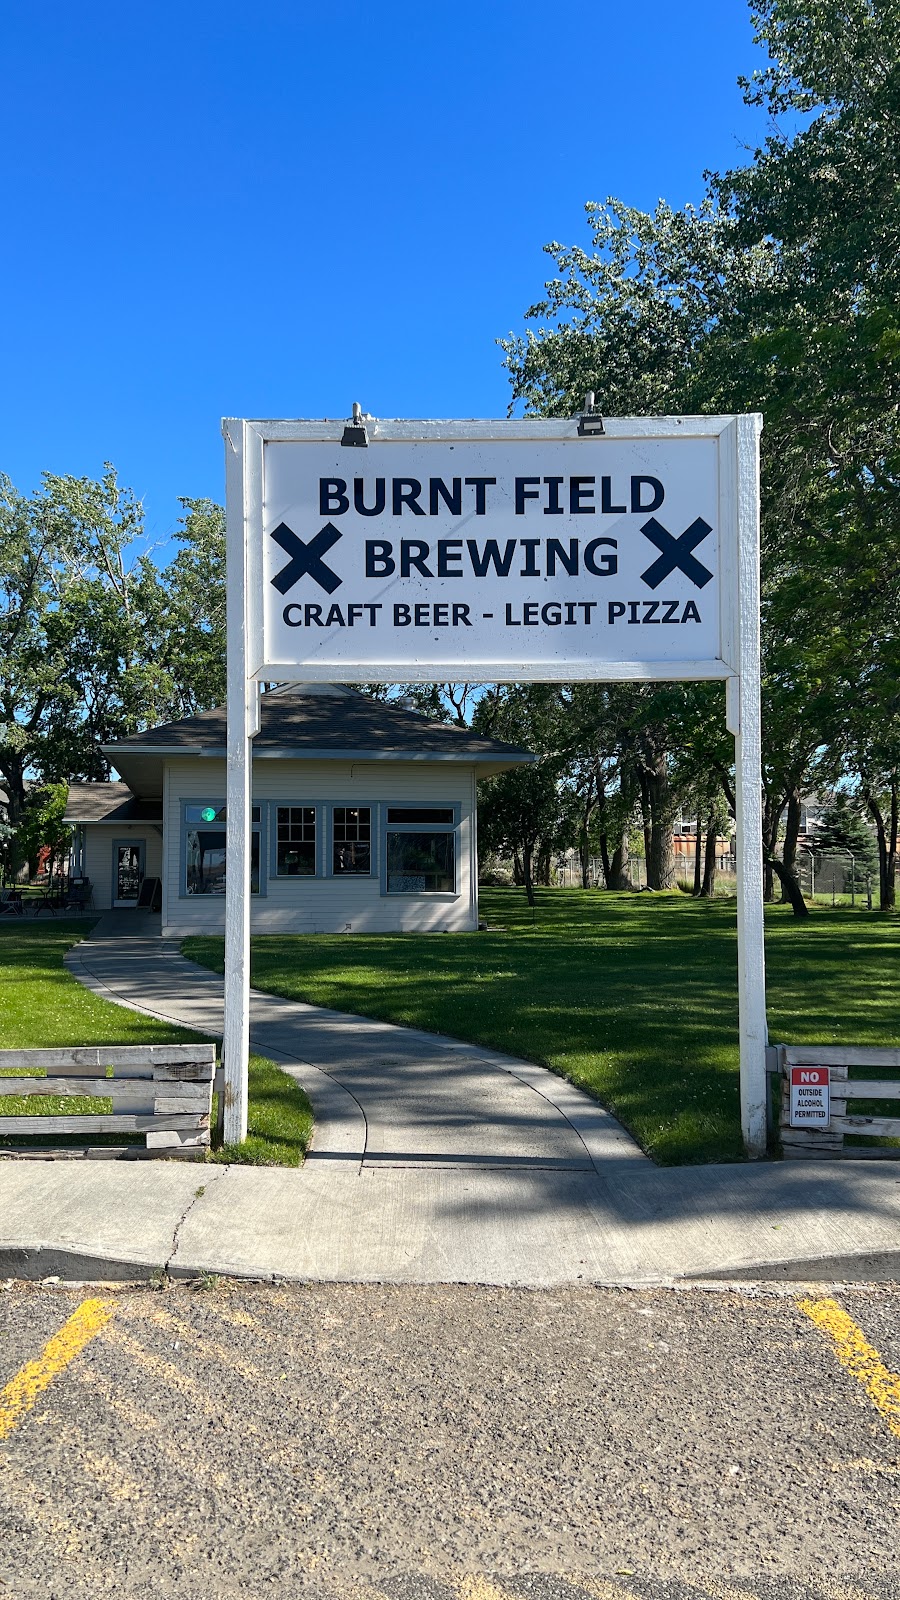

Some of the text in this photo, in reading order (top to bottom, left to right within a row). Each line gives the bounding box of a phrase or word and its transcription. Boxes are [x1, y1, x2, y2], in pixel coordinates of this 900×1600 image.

[319, 475, 665, 517] BURNT FIELD
[365, 537, 618, 578] BREWING
[282, 603, 383, 628] CRAFT
[393, 603, 474, 627] BEER
[505, 602, 598, 626] LEGIT
[608, 600, 702, 625] PIZZA
[800, 1071, 820, 1083] NO
[798, 1088, 823, 1097] OUTSIDE
[797, 1099, 824, 1107] ALCOHOL
[794, 1110, 826, 1118] PERMITTED
